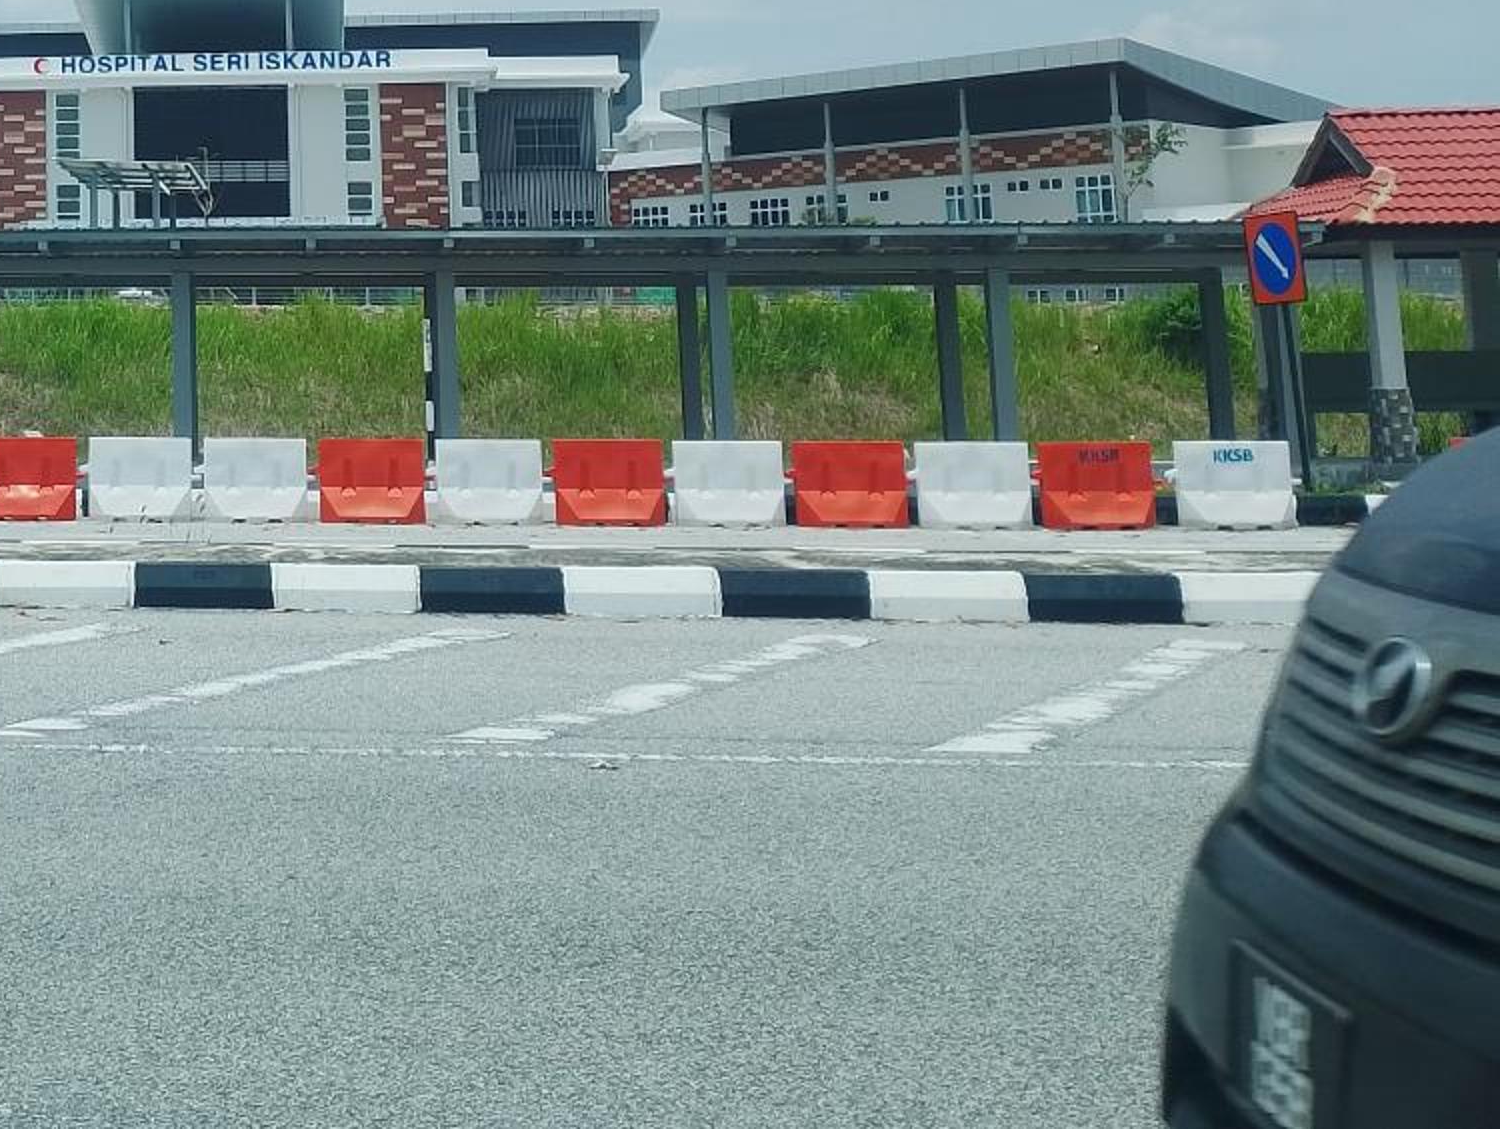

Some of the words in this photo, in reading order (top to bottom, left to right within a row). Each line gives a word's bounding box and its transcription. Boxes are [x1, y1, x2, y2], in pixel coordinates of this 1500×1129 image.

[61, 55, 185, 73] HOSPITAL
[193, 54, 249, 71] SERI
[259, 51, 391, 70] ISKANDAR
[1213, 448, 1254, 463] KKSB
